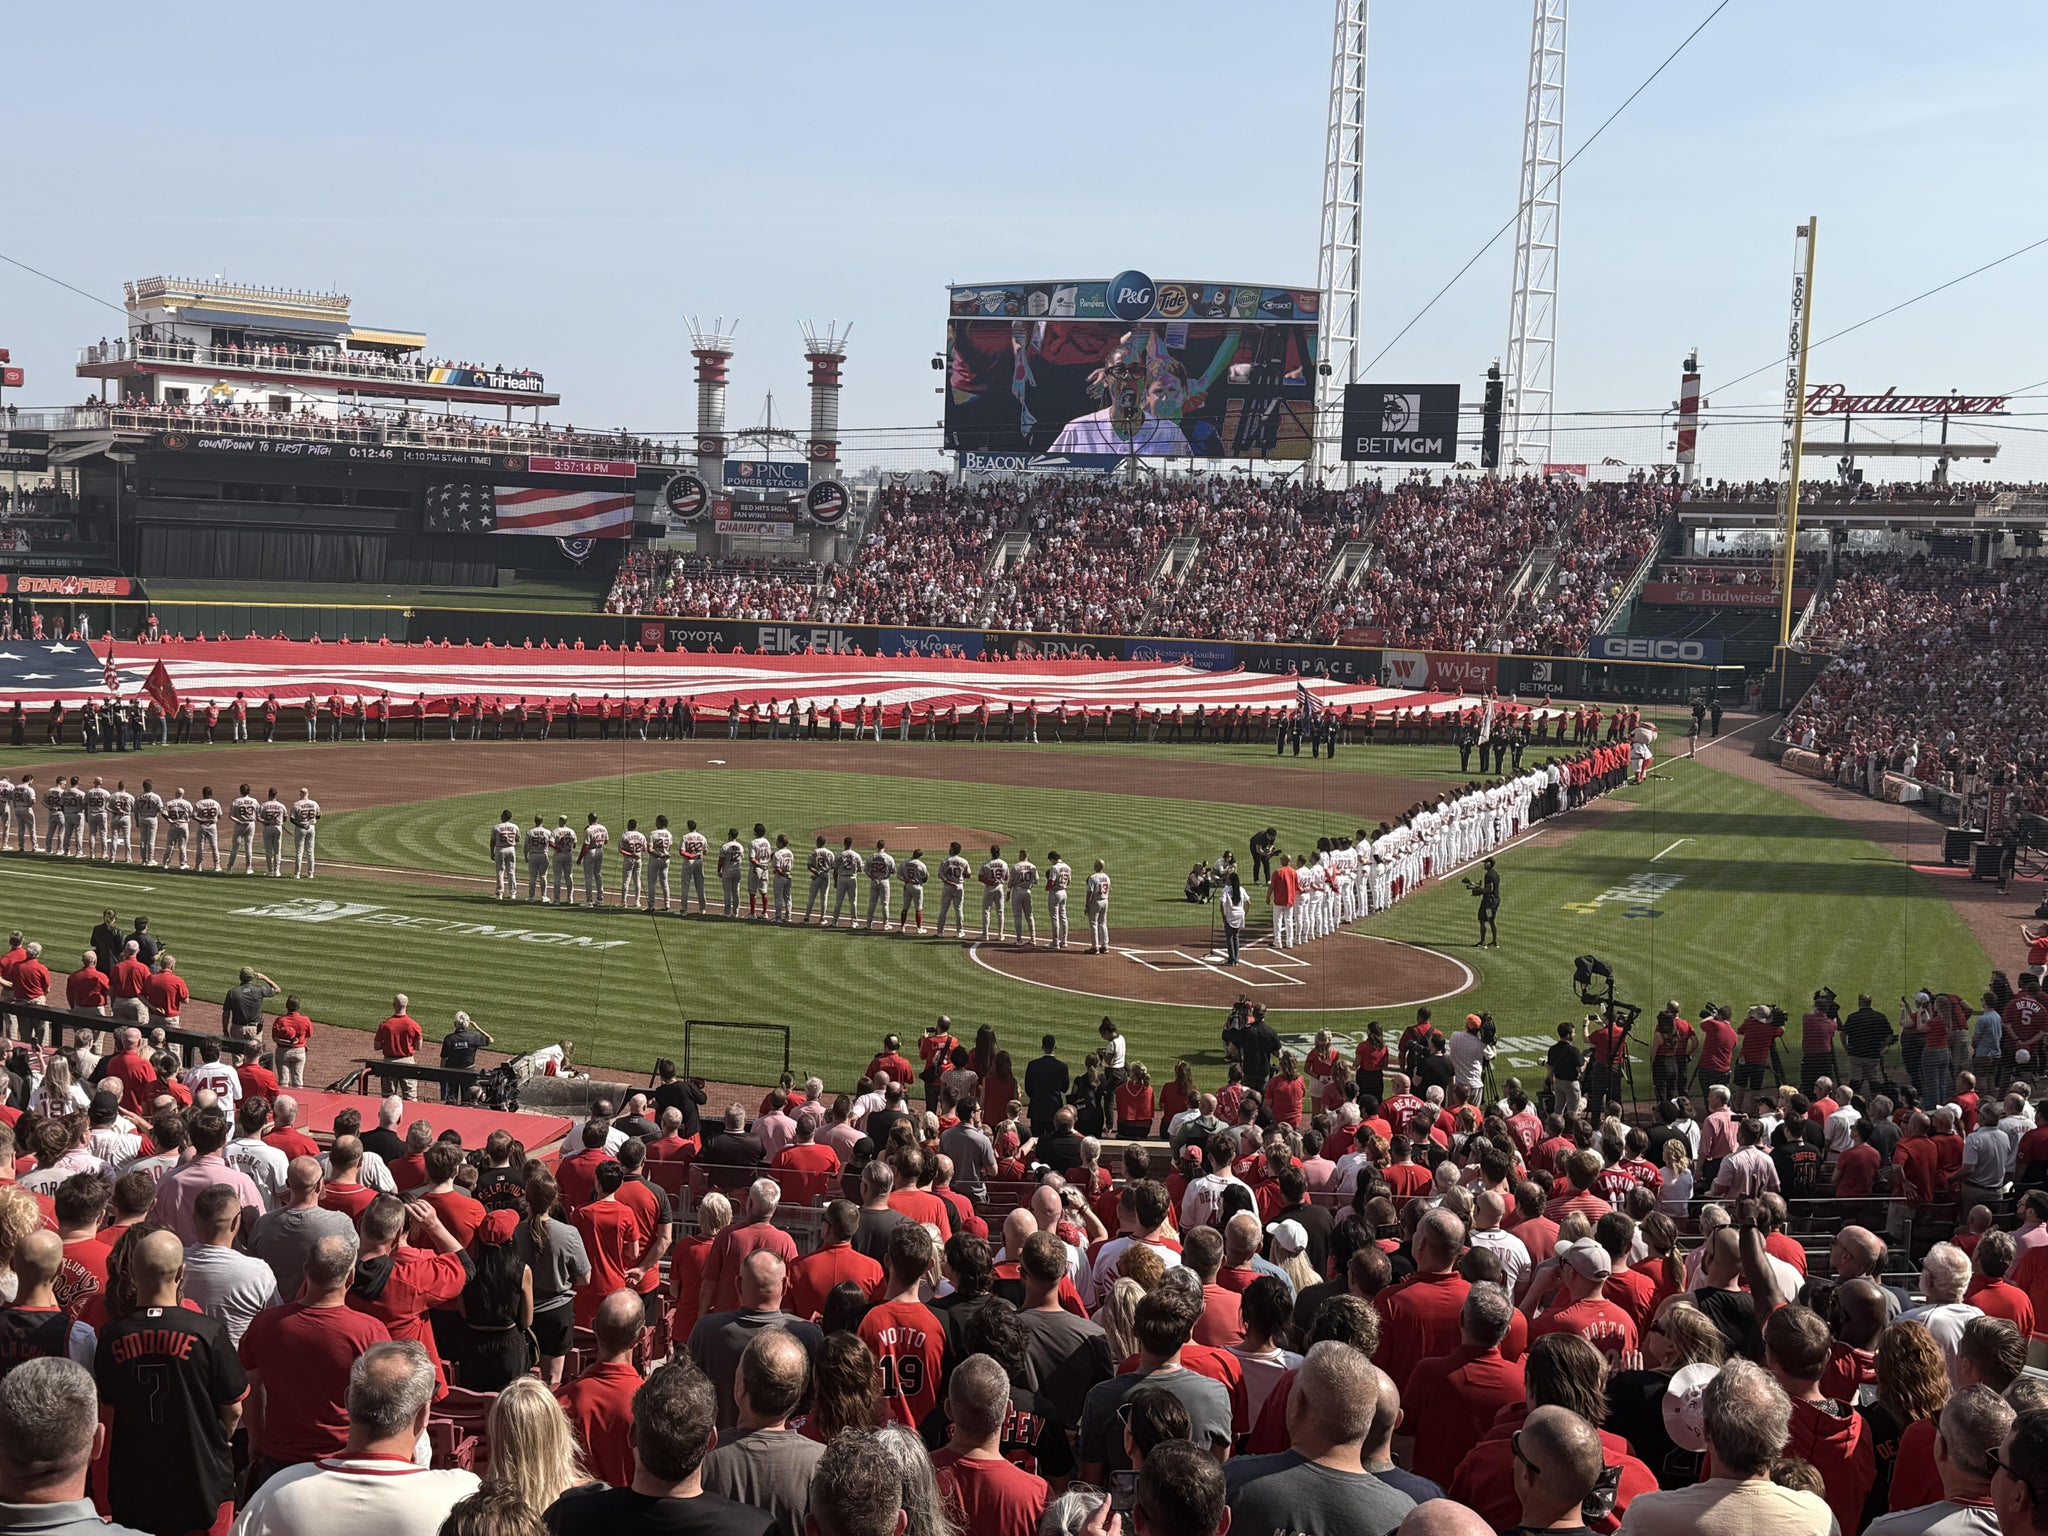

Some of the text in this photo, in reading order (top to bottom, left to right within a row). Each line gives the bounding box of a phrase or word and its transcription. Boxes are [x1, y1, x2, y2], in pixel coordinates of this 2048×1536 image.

[1117, 288, 1151, 304] P&G
[1158, 293, 1186, 312] Tide
[1792, 276, 1803, 318] ROOT
[1790, 322, 1799, 361] ROOT
[486, 373, 542, 392] TriHealth
[1786, 368, 1797, 410] ROOT
[1804, 383, 2007, 416] Budweiser
[1785, 417, 1794, 428] 4
[198, 438, 393, 459] COUNTDOWN TO FIRST PITCH 0:12:46
[1356, 437, 1442, 454] BETMGM
[403, 451, 492, 466] [4:10 PM START TIME]
[965, 452, 1026, 470] BEACON
[1782, 440, 1792, 471] THA
[554, 460, 609, 473] 3:57:14 PM
[756, 463, 794, 479] PNC
[727, 477, 804, 488] POWER STACKS
[770, 505, 789, 514] SIGN,
[17, 577, 118, 594] STAR FIRE
[1701, 588, 1780, 604] Budweiser
[670, 630, 724, 643] TOYOTA
[920, 634, 963, 652] Kroger
[985, 634, 999, 642] 370
[1041, 641, 1096, 660] PNC
[1193, 651, 1225, 661] Southern
[1604, 638, 1704, 660] GEICO
[1258, 656, 1354, 675] MEDPACE
[1436, 660, 1490, 683] Wyler
[1519, 682, 1564, 694] BETMGM
[500, 833, 516, 845] 55
[688, 842, 703, 852] 22
[356, 913, 632, 950] BETMGM
[2016, 1001, 2041, 1013] BENCH
[2021, 1010, 2032, 1025] 5
[195, 1076, 229, 1097] 45
[1393, 1099, 1421, 1111] BENCH
[1522, 1130, 1532, 1146] 6
[1627, 1166, 1656, 1181] ENCH
[490, 1183, 502, 1196] LA
[503, 1183, 526, 1198] CRUZ
[1598, 1175, 1634, 1191] LARKIN
[52, 1272, 100, 1306] Reds
[878, 1326, 927, 1350] VOTTO
[1582, 1320, 1625, 1342] VOTTO
[111, 1329, 199, 1364] SMOOVE
[879, 1354, 924, 1399] 19
[137, 1363, 169, 1424] 7
